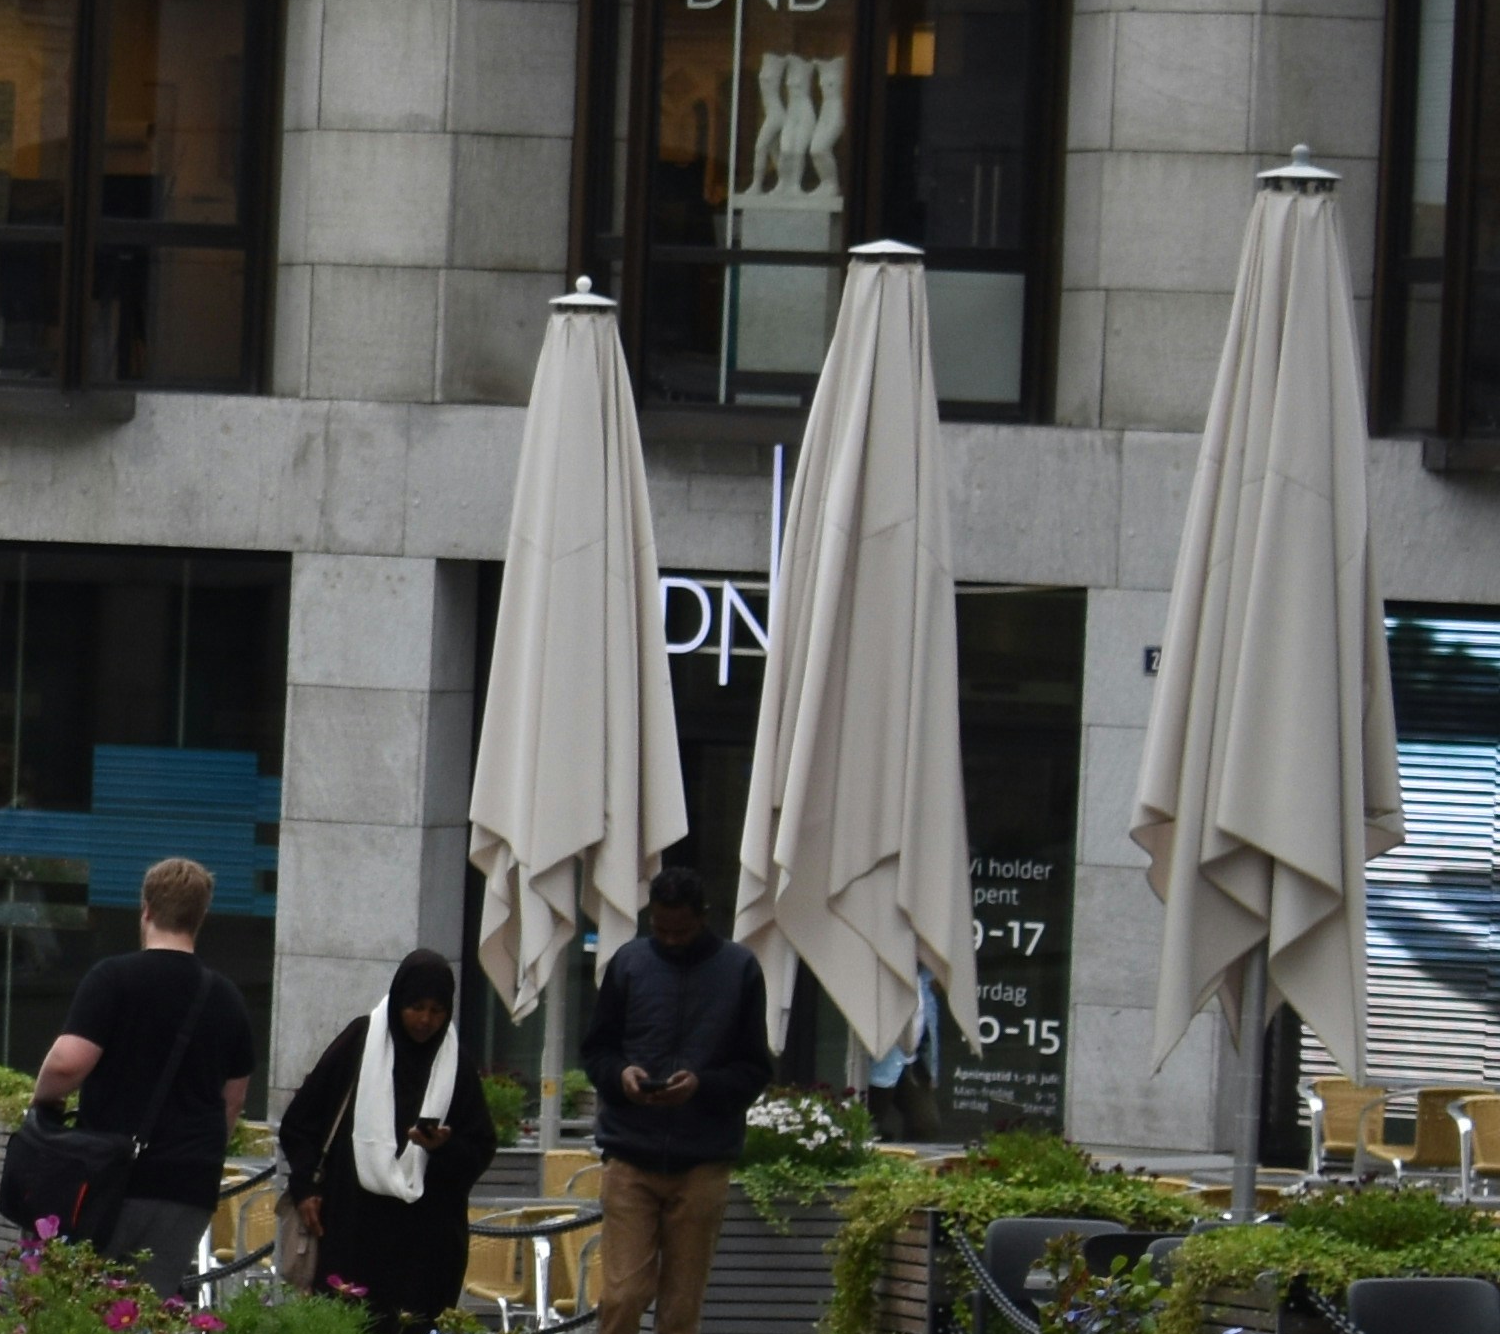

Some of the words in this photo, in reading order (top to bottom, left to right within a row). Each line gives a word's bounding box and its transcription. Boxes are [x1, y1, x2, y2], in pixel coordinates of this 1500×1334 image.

[988, 857, 1053, 880] holder
[974, 887, 1019, 907] pent
[961, 1015, 1061, 1055] 0-15
